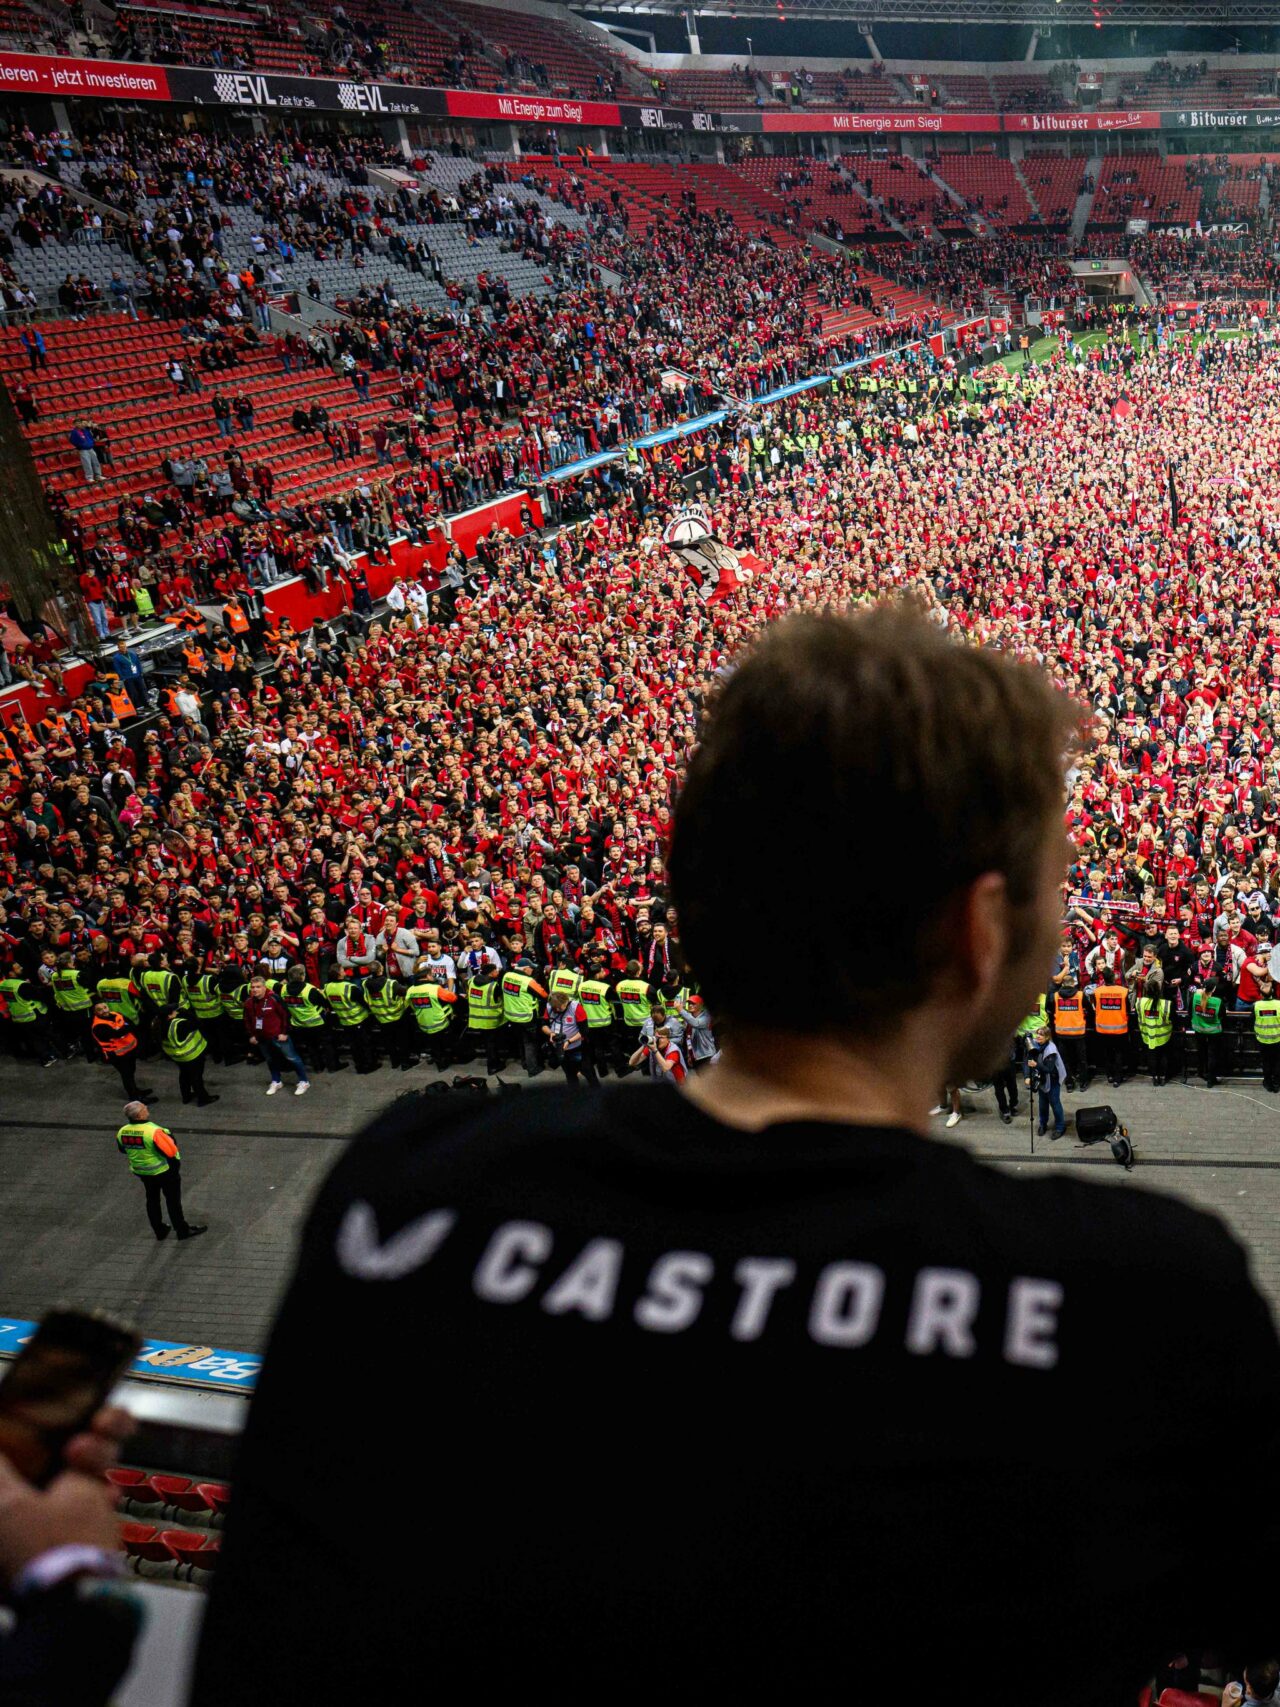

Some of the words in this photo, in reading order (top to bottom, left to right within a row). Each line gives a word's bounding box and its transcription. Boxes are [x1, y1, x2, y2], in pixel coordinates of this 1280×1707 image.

[0, 63, 38, 82] ieren
[51, 67, 83, 87] jetzt
[85, 70, 156, 90] investieren
[234, 76, 277, 105] EVL
[354, 85, 388, 111] EVL
[278, 95, 292, 106] Zeit
[390, 102, 400, 112] Zeit
[499, 99, 513, 114] Mit
[514, 100, 545, 119] Energie
[546, 105, 563, 118] zum
[563, 103, 582, 122] Sieg!
[1128, 113, 1141, 123] Bit
[833, 116, 849, 128] Mit
[852, 116, 891, 130] Energie
[894, 120, 915, 128] zum
[918, 116, 942, 130] Sieg!
[1033, 115, 1088, 129] Bitburger
[1191, 111, 1247, 126] Bitburger
[472, 1219, 1064, 1370] CASTORE
